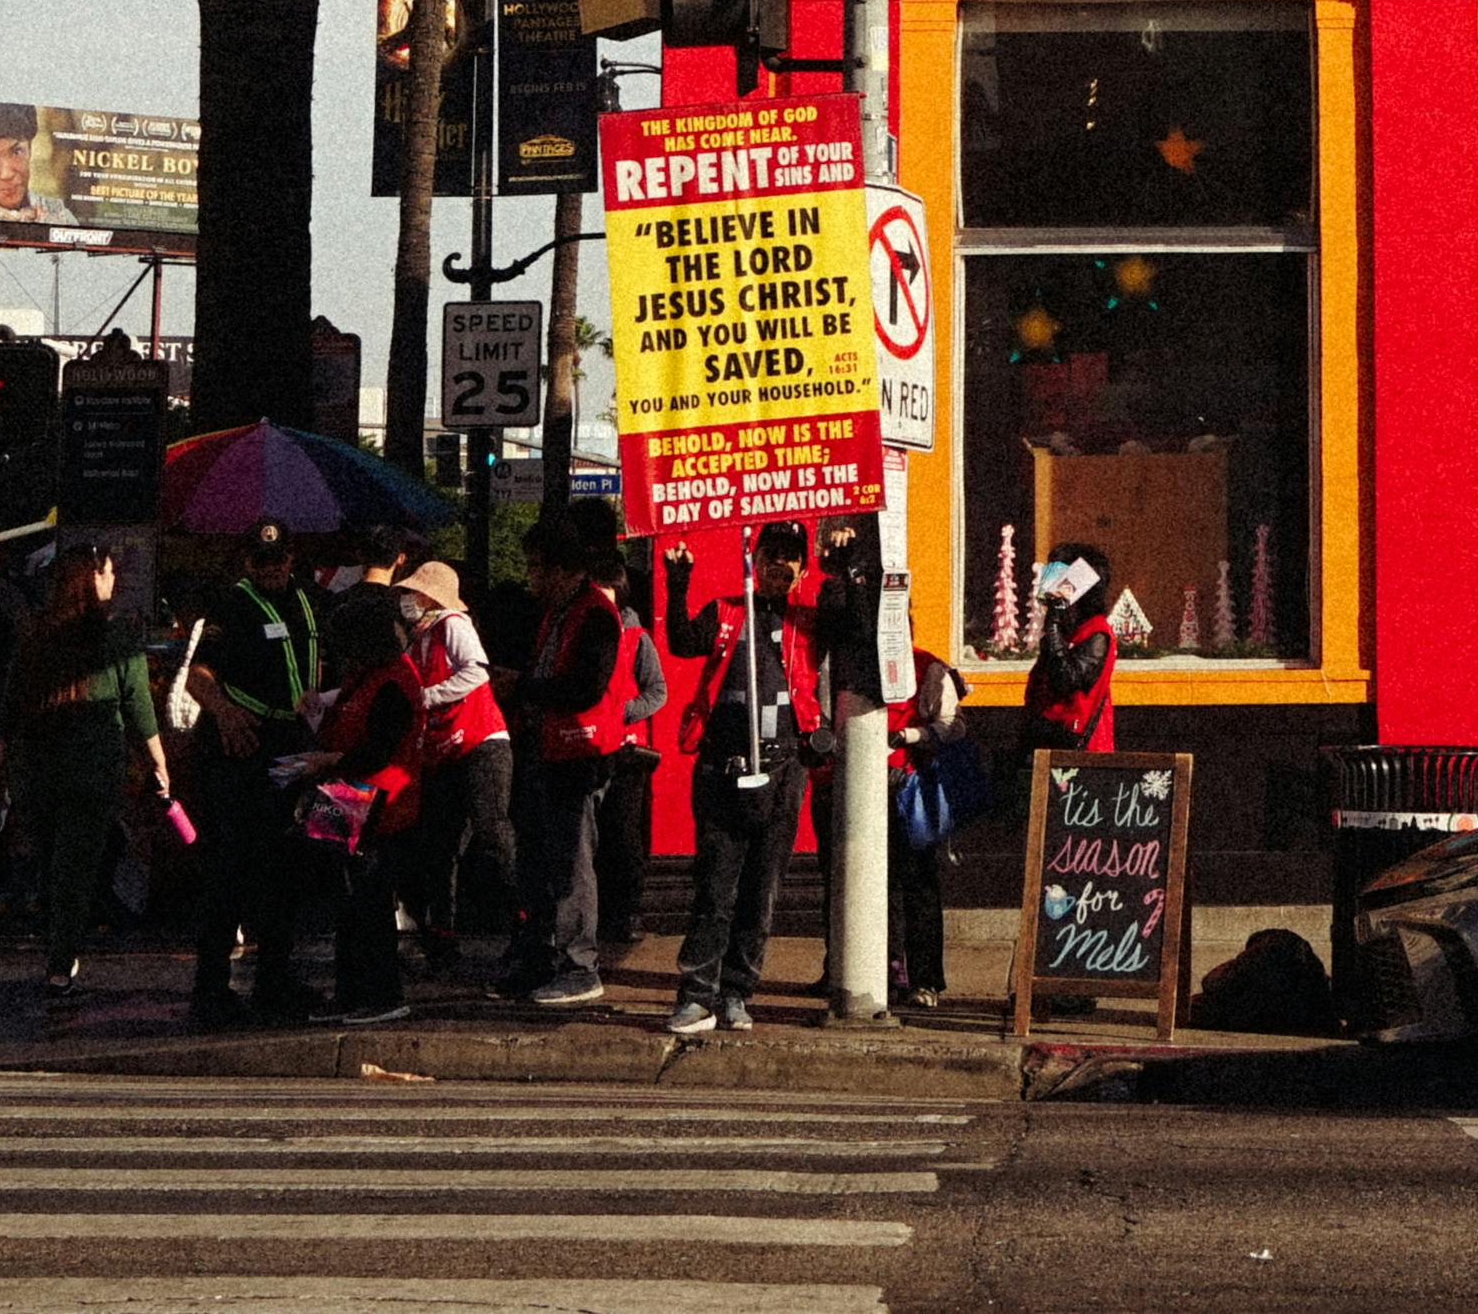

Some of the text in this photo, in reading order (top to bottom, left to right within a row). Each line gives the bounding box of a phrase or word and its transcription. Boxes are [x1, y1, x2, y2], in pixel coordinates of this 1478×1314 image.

[504, 2, 580, 16] HOLLYWOO
[641, 106, 818, 137] THE KINGDOM OF GOD
[664, 126, 798, 152] HAS COME NEAR.
[72, 149, 199, 175] NICKEL BO
[615, 142, 854, 202] REPENT OF YOUR
[774, 162, 855, 188] SINS AND
[111, 187, 144, 199] PICTURE
[146, 189, 158, 200] OF
[160, 190, 175, 201] THE
[634, 206, 821, 249] "BELIEVE IN
[665, 244, 813, 284] THE LORD
[634, 276, 857, 323] JESUS CHRIST,
[453, 314, 534, 332] SPEED
[640, 312, 852, 353] AND YOU WILL BE
[459, 342, 525, 361] LIMIT
[704, 347, 814, 384] SAVED,
[828, 363, 859, 375] 16:31
[834, 351, 859, 363] ACTS
[452, 371, 530, 415] 25
[629, 397, 664, 415] YOU
[670, 394, 701, 412] AND
[706, 388, 752, 407] YOUR
[882, 378, 929, 422] N RED
[647, 419, 854, 458] BEHOLD, NOW IS THE
[671, 444, 831, 479] ACCEPTED TIME;
[601, 479, 613, 490] Pl
[652, 463, 859, 503] BEHOLD, NOW IS THE
[861, 484, 881, 495] COR
[662, 487, 852, 525] DAY OF SALVATION.
[1112, 782, 1159, 827] the
[1047, 833, 1161, 880] season
[1076, 881, 1123, 924] for
[1049, 920, 1150, 972] Mels
